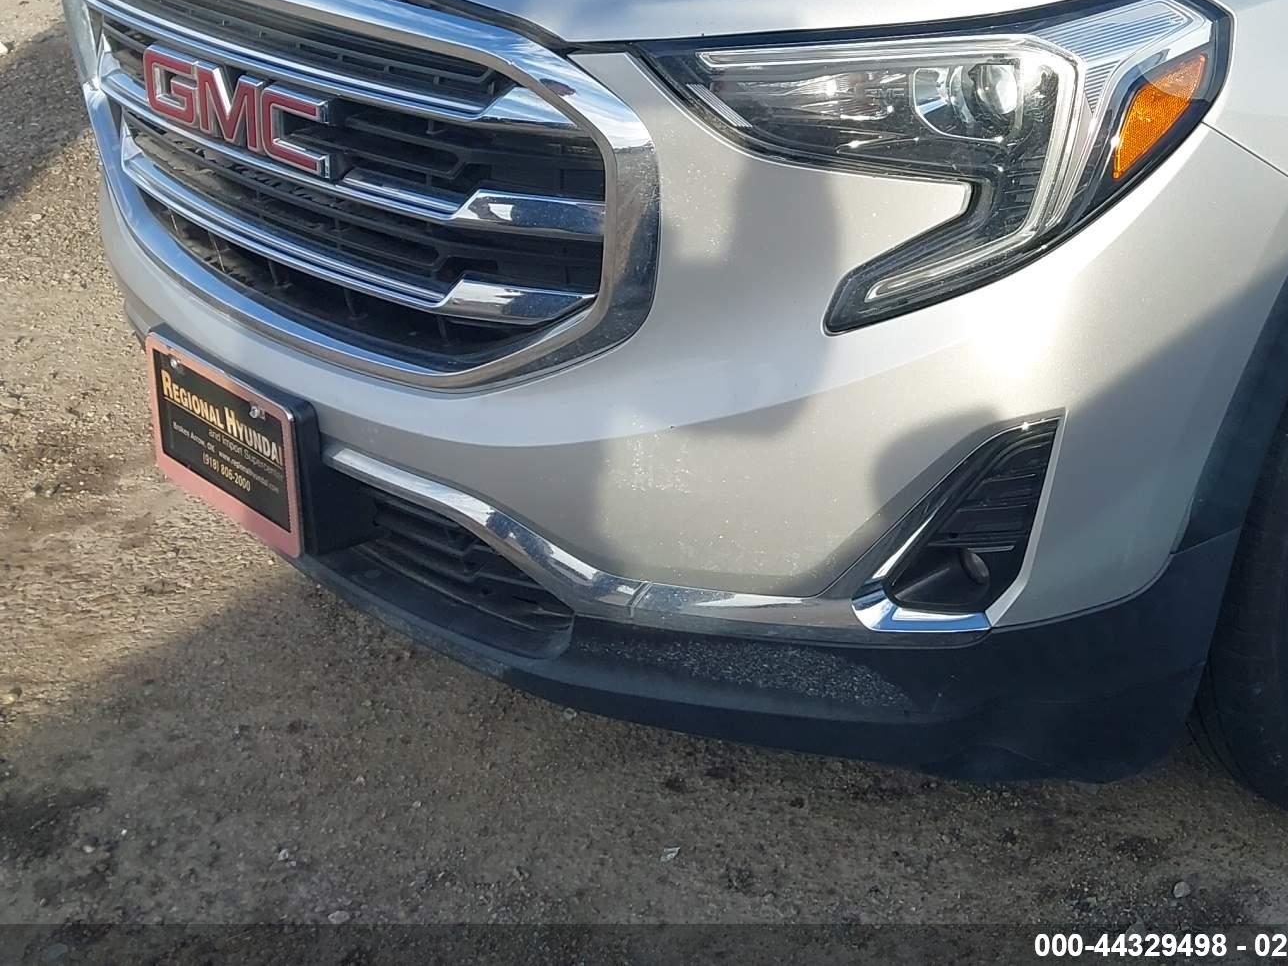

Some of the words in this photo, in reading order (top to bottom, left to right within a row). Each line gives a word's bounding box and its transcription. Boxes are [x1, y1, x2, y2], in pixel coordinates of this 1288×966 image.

[143, 44, 330, 179] GMC
[160, 369, 225, 429] REGIONAL
[224, 406, 284, 466] HYUNDAI
[208, 428, 222, 443] and
[222, 434, 243, 457] Import
